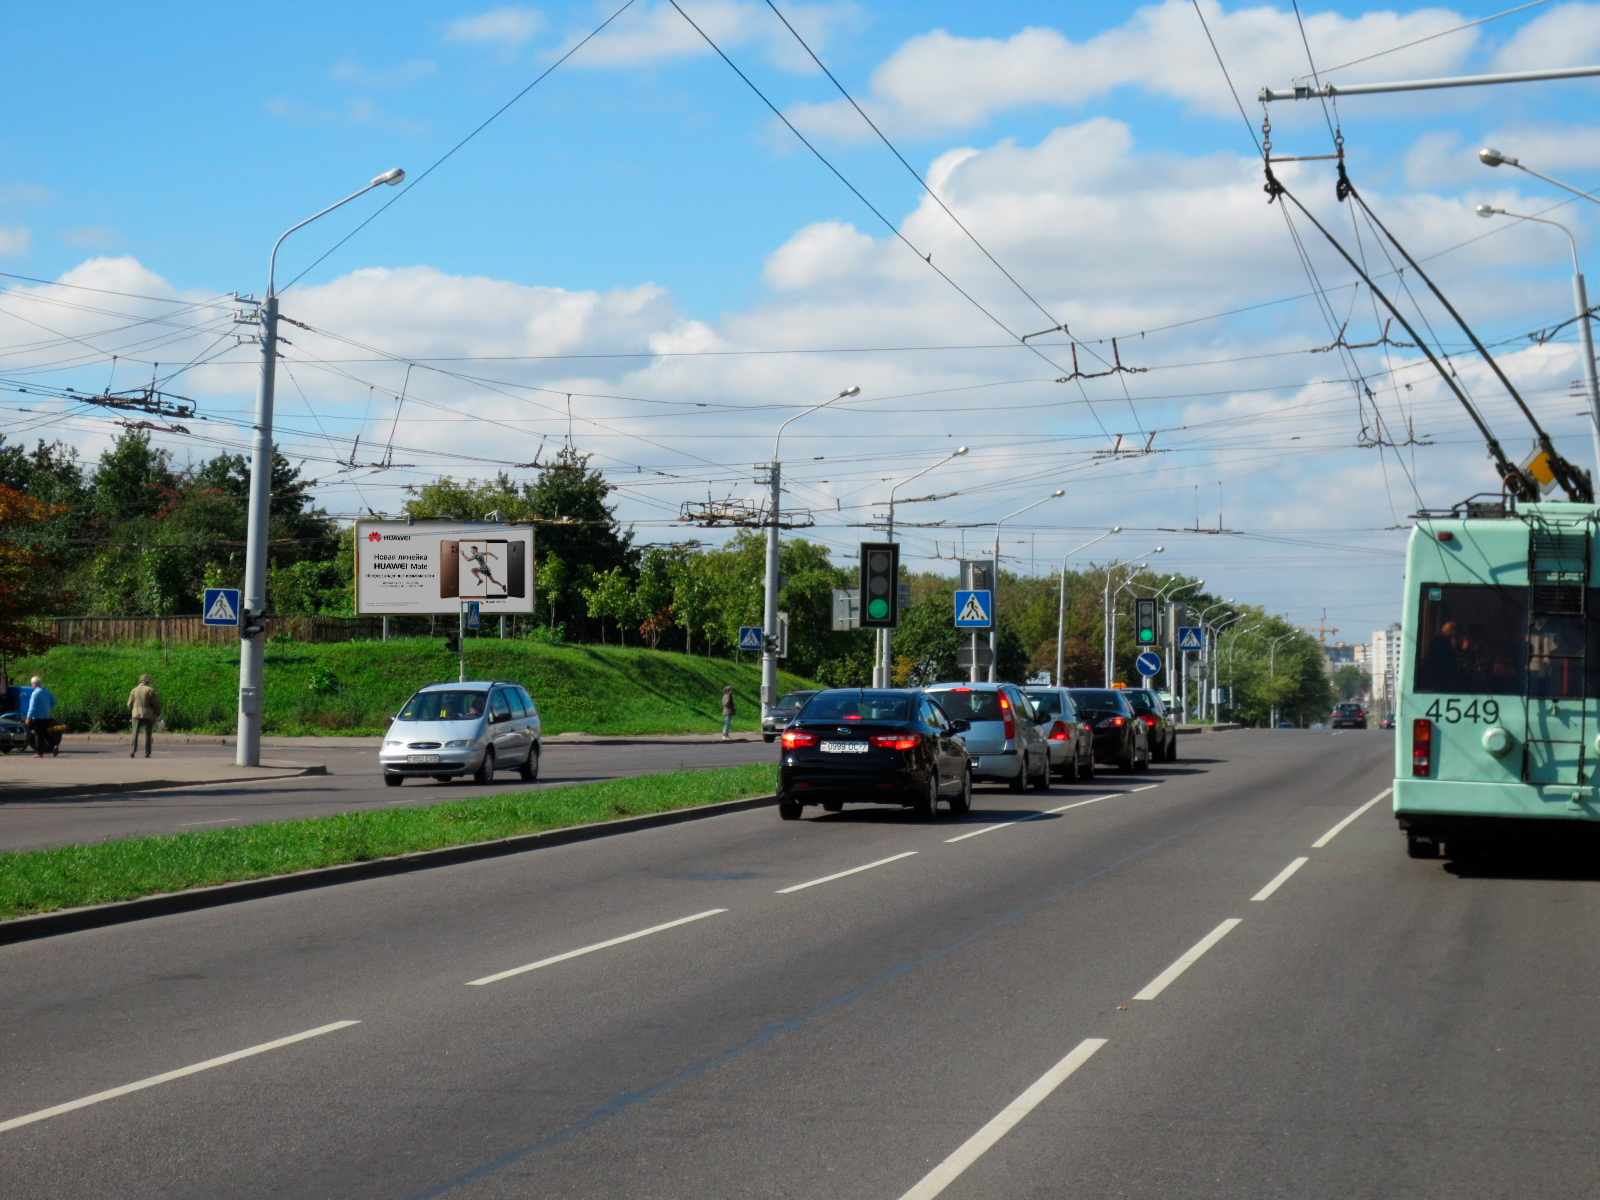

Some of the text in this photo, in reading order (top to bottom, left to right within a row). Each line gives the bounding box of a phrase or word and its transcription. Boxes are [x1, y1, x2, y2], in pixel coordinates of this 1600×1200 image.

[373, 553, 428, 561] Новая линейка
[373, 562, 408, 570] HUAWEI
[1425, 698, 1499, 725] 4549
[827, 742, 846, 751] 0999
